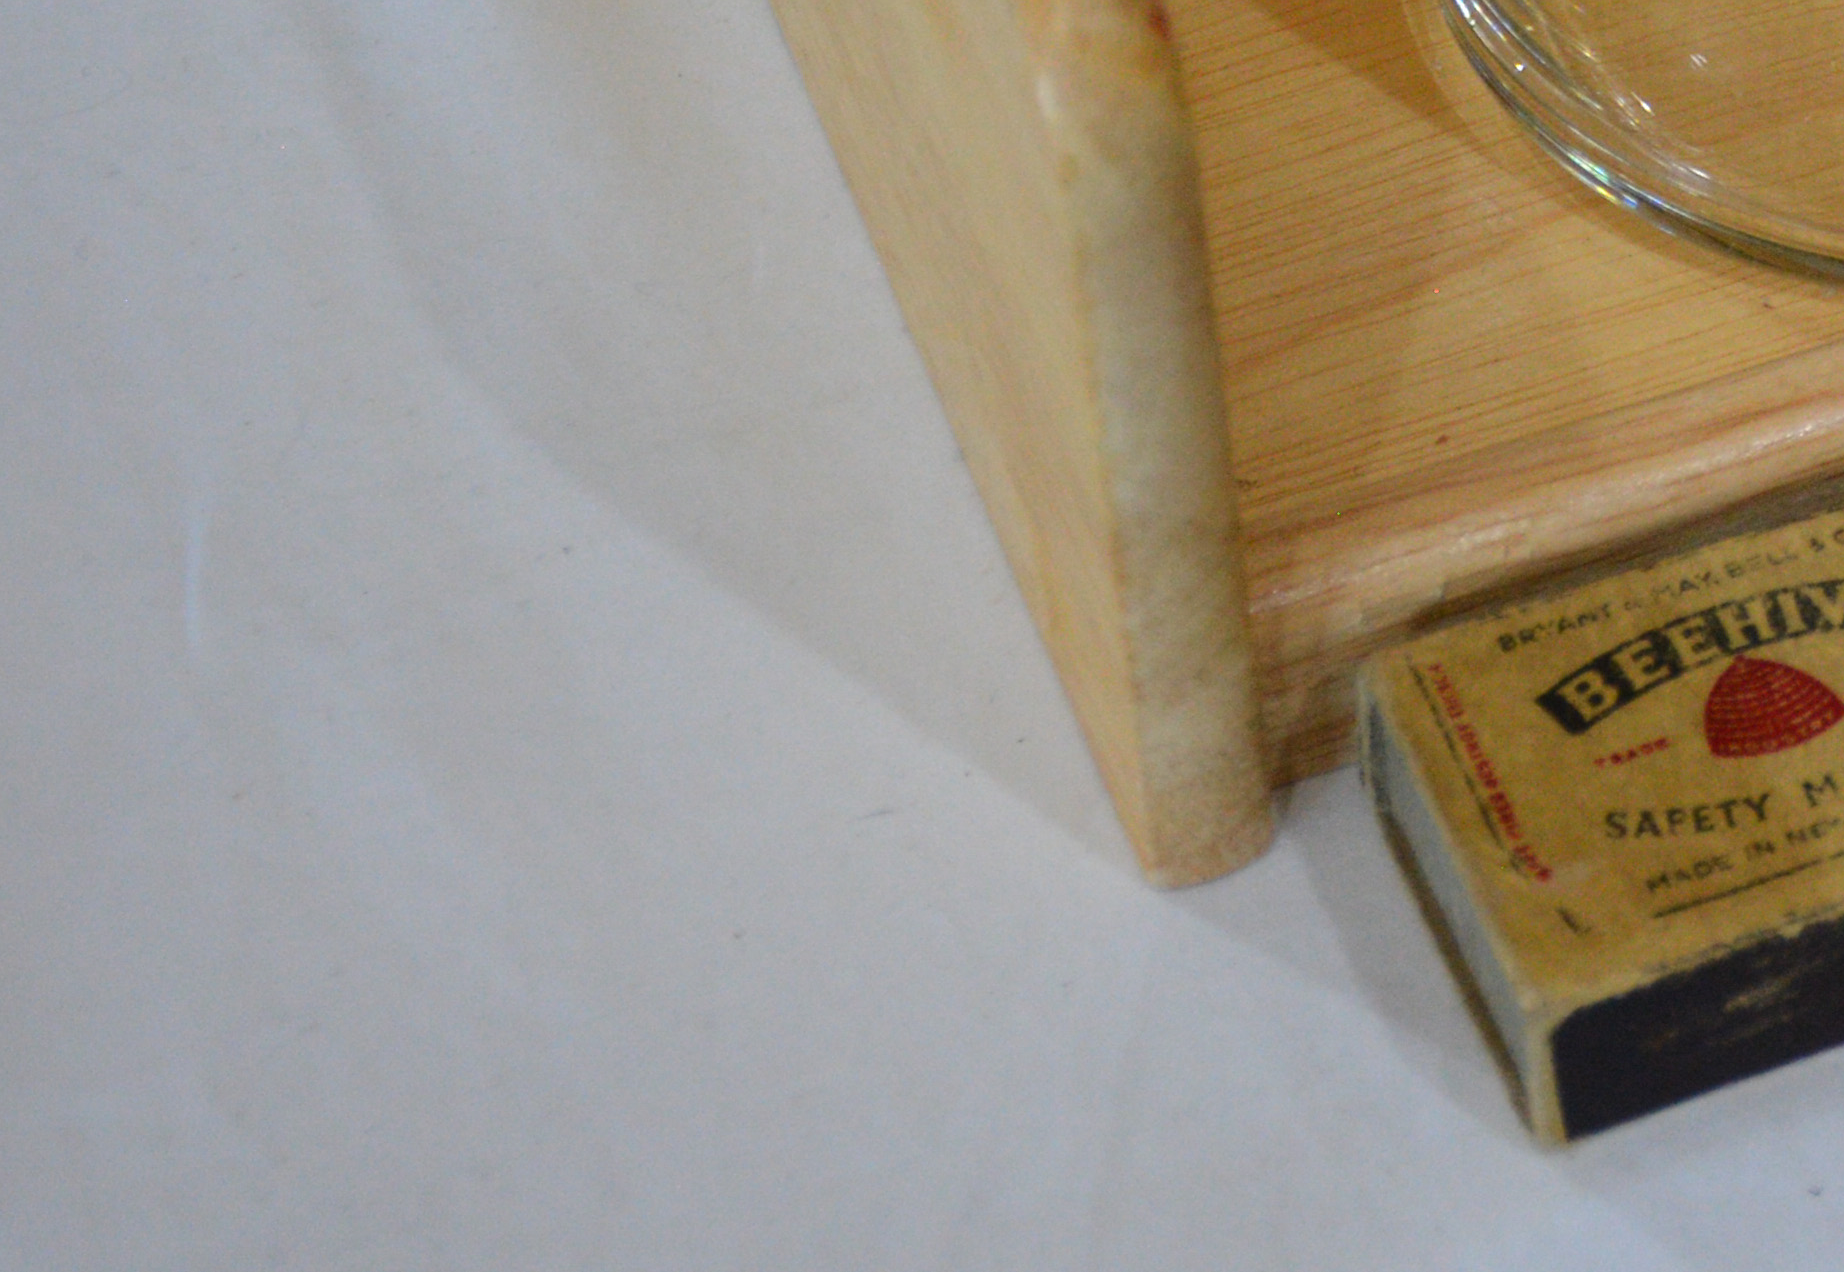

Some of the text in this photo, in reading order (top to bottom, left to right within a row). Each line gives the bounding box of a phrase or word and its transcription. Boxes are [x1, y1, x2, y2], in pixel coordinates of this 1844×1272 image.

[1498, 602, 1611, 653] BRYANT
[1592, 737, 1672, 770] TRADE
[1604, 792, 1771, 840] SAFETY
[1646, 856, 1734, 893] MADE
[1744, 841, 1776, 861] IN
